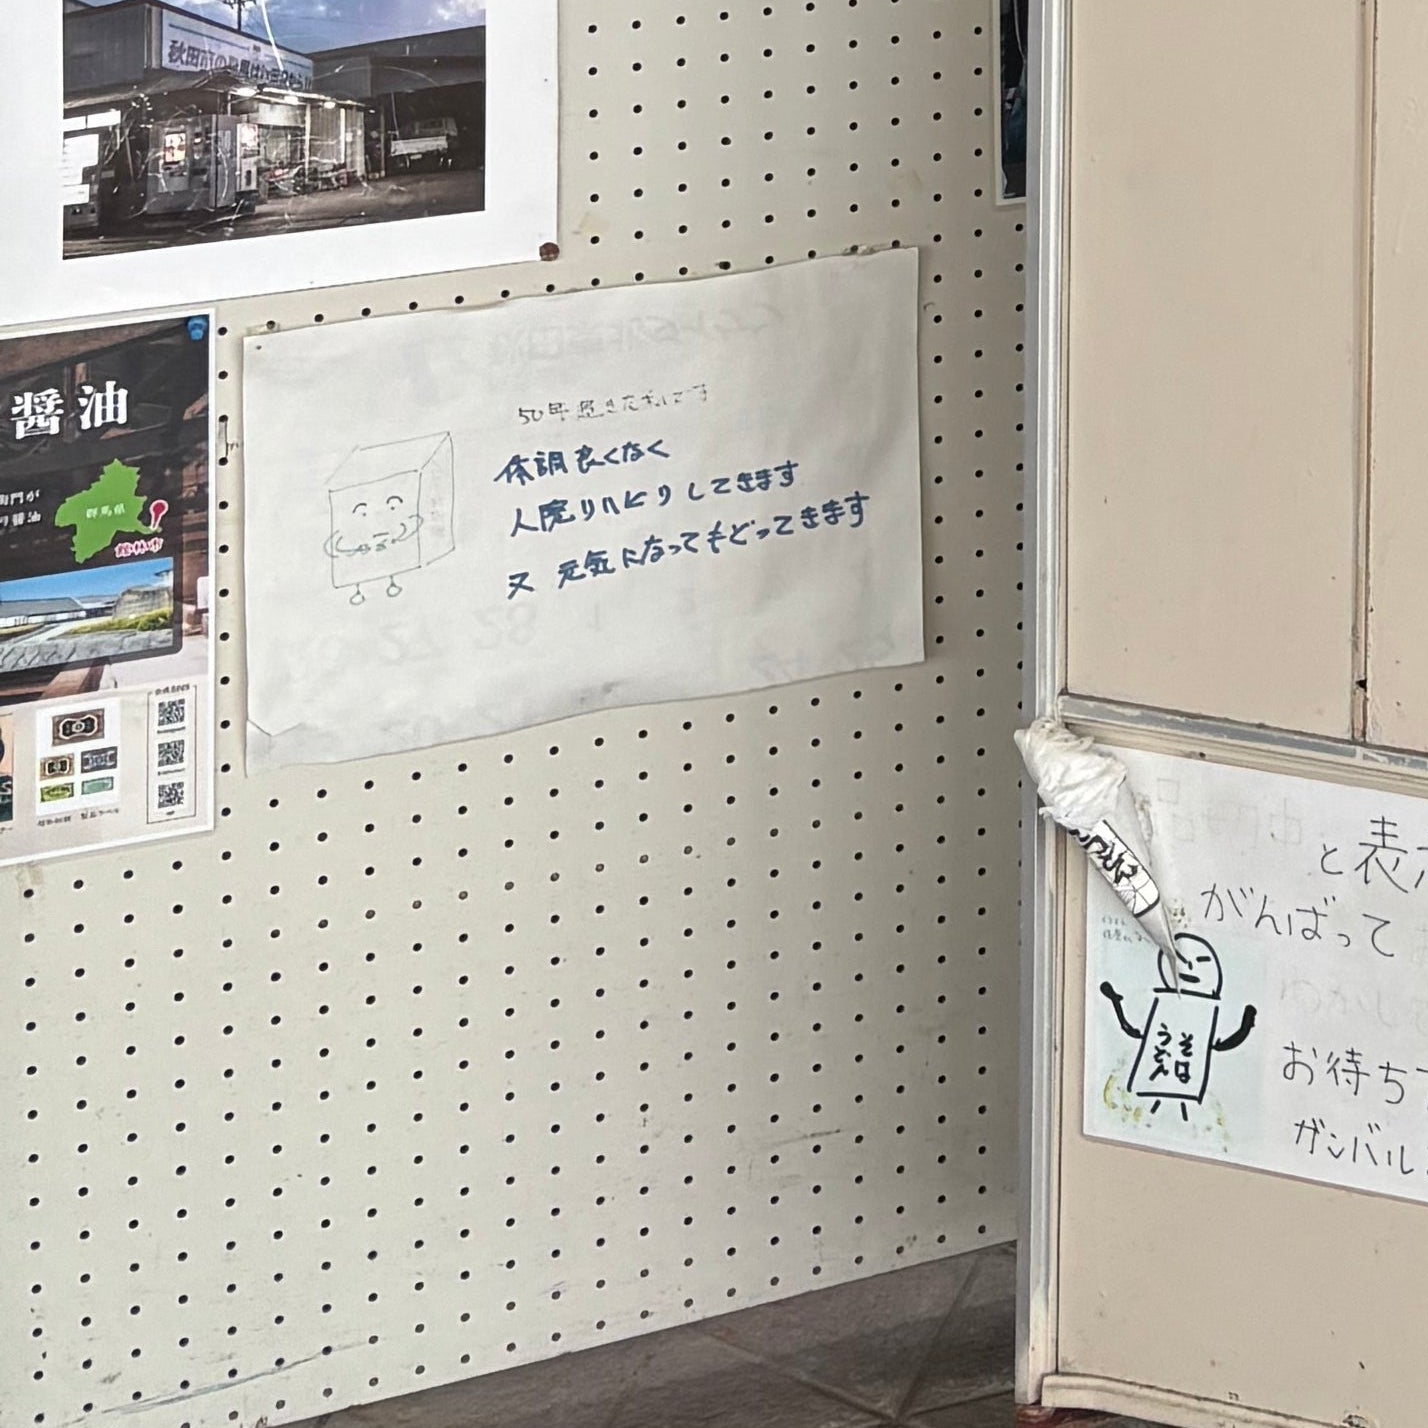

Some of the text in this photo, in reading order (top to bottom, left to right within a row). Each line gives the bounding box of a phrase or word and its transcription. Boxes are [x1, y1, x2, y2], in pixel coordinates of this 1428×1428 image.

[10, 379, 130, 442] 醤油
[1200, 882, 1395, 958] がんばって
